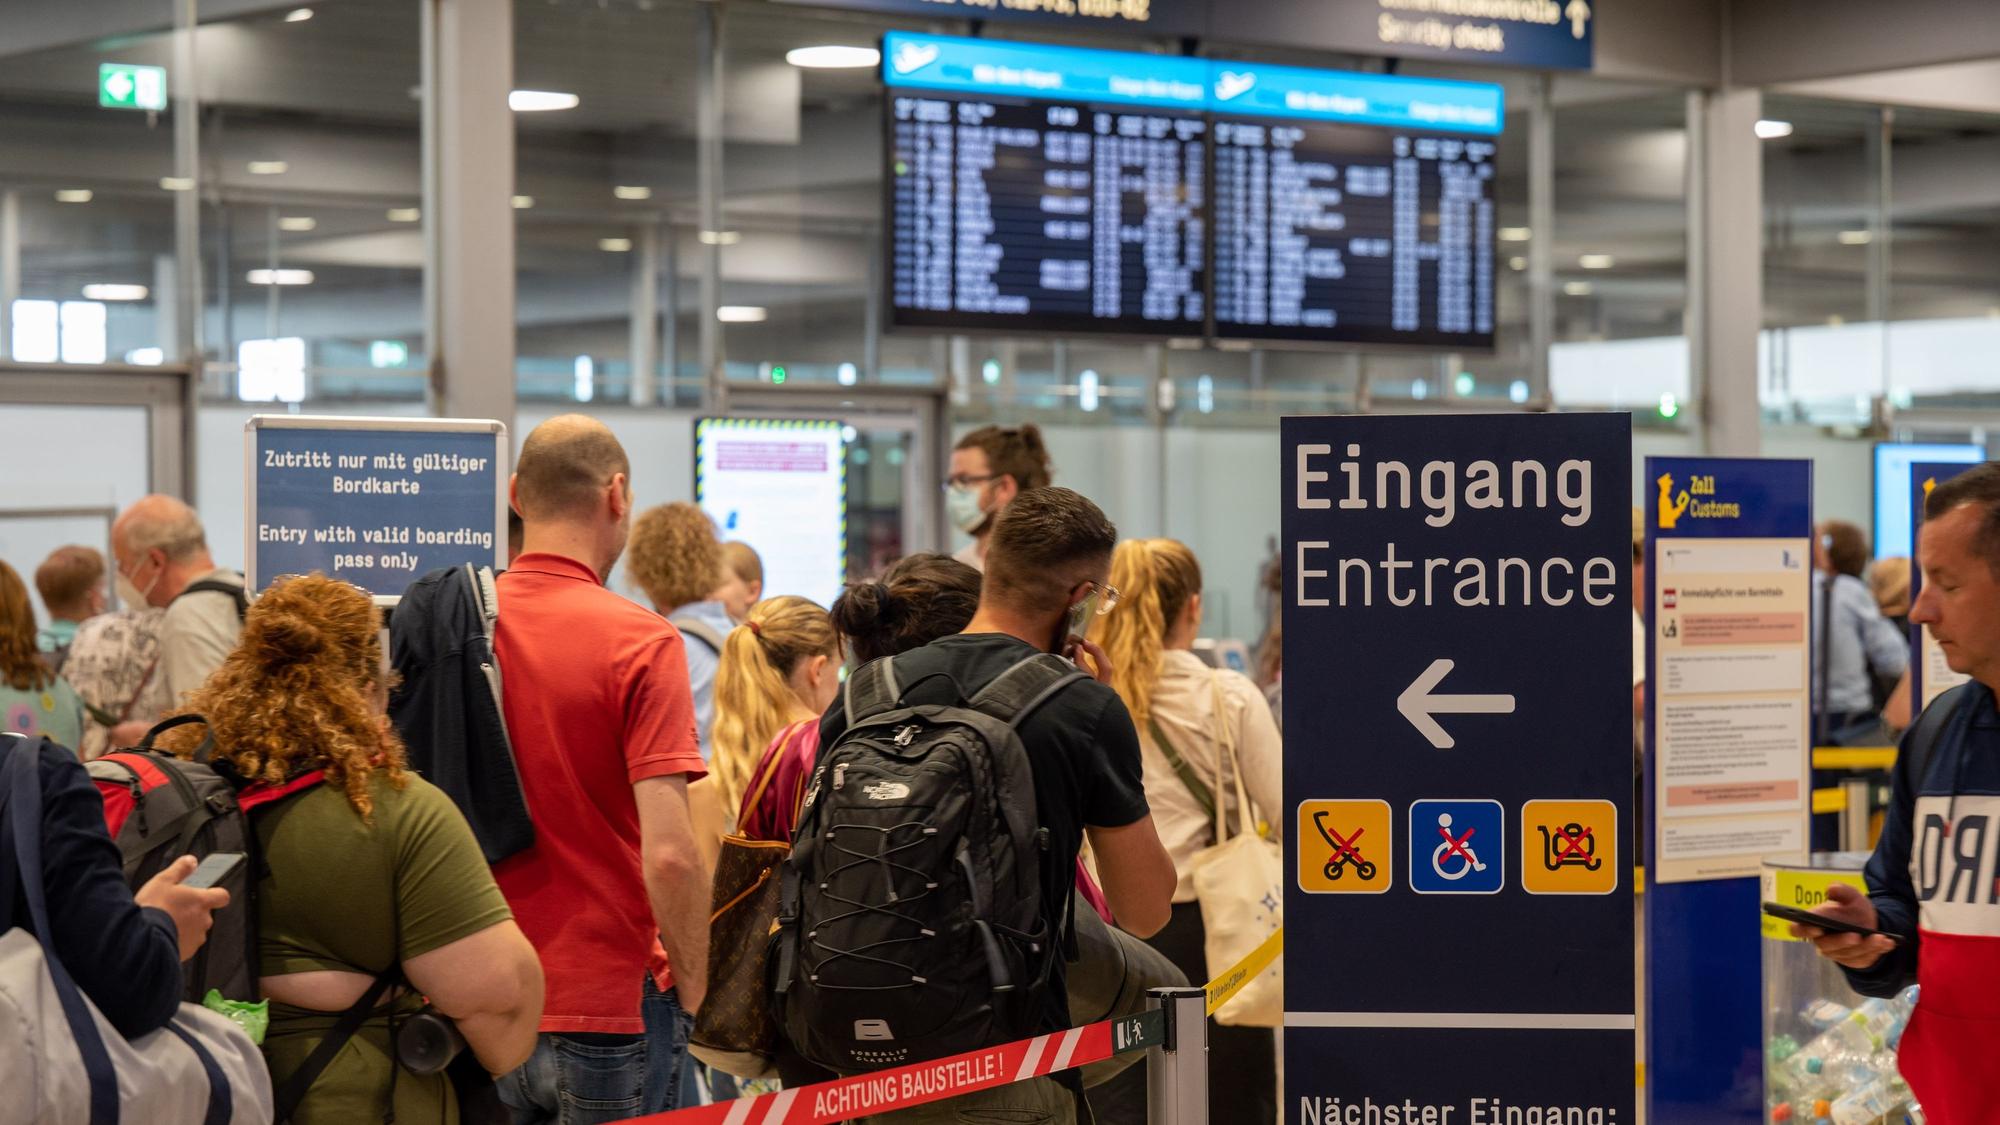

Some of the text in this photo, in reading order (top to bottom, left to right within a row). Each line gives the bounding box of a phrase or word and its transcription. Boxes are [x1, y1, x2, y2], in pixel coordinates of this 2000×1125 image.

[265, 450, 487, 474] Zutritt nur mit gültiger
[333, 477, 420, 494] Bordkarte
[1297, 444, 1592, 527] Eingang
[1690, 475, 1715, 494] Zoll
[1690, 499, 1740, 518] Customs
[259, 525, 492, 549] Entry with valid boarding
[334, 552, 418, 571] pass only
[1297, 541, 1616, 607] Entrance
[850, 1048, 908, 1057] BOREALIS
[856, 1055, 905, 1063] CLASSIC
[814, 1075, 898, 1118] ACHTUNG
[1301, 1096, 1617, 1125] Nächster Eingang:
